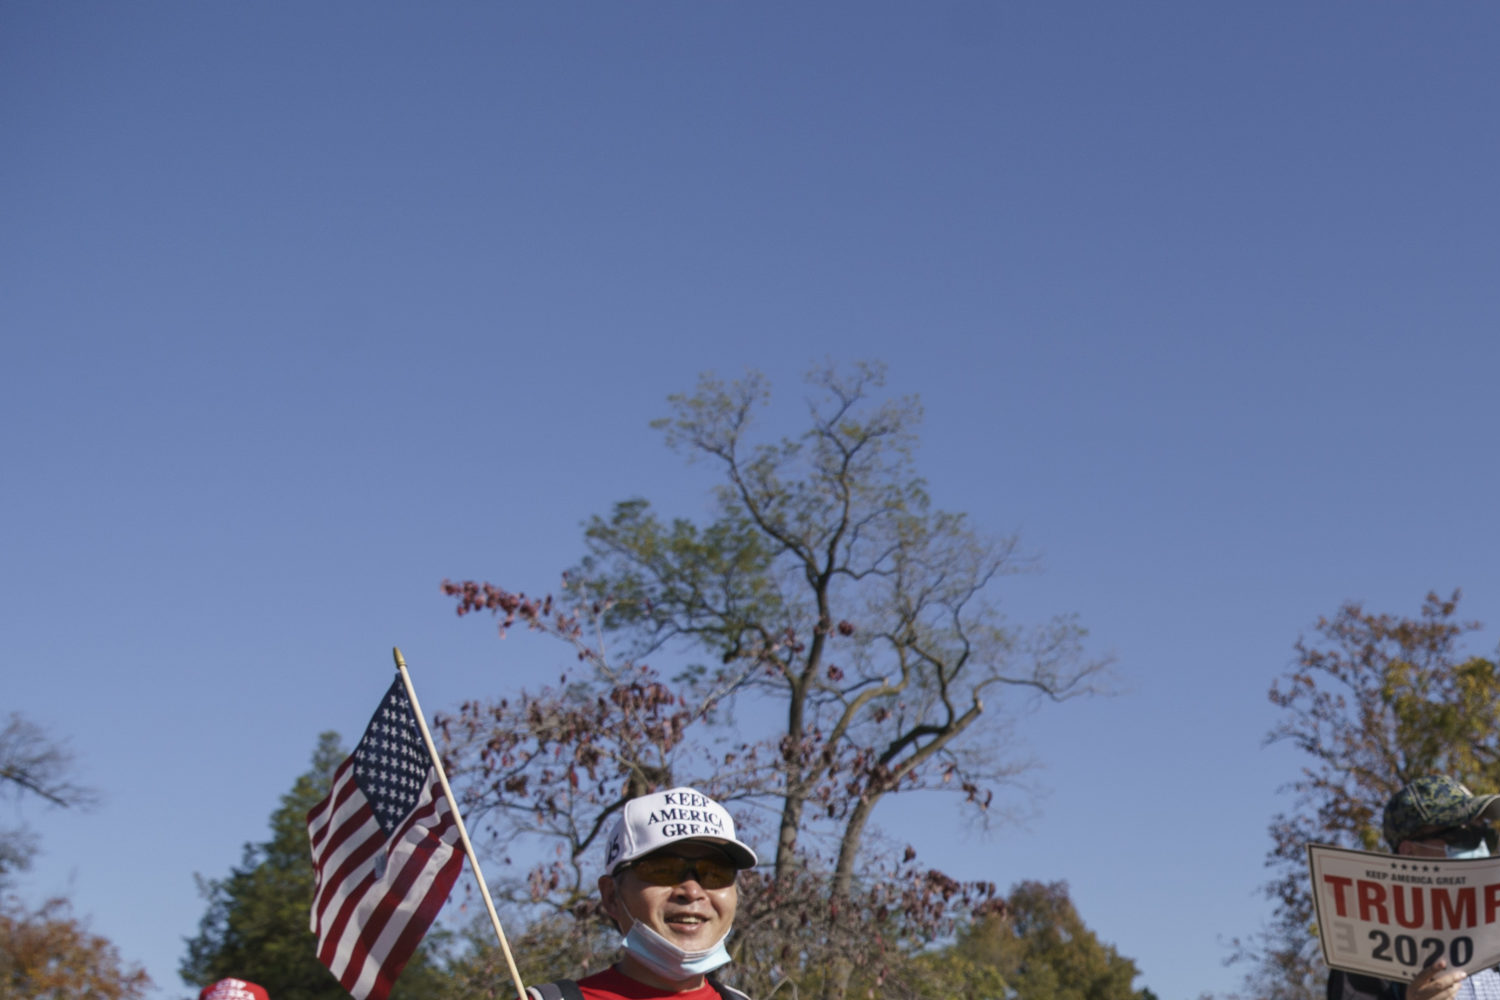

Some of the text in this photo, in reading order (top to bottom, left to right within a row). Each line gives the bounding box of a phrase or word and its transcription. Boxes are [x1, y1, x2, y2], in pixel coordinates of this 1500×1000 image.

[664, 792, 711, 808] KEEP
[648, 808, 725, 832] AMERICA
[1365, 869, 1467, 885] KEEP AMERICA GREAT
[1368, 929, 1474, 969] 2020
